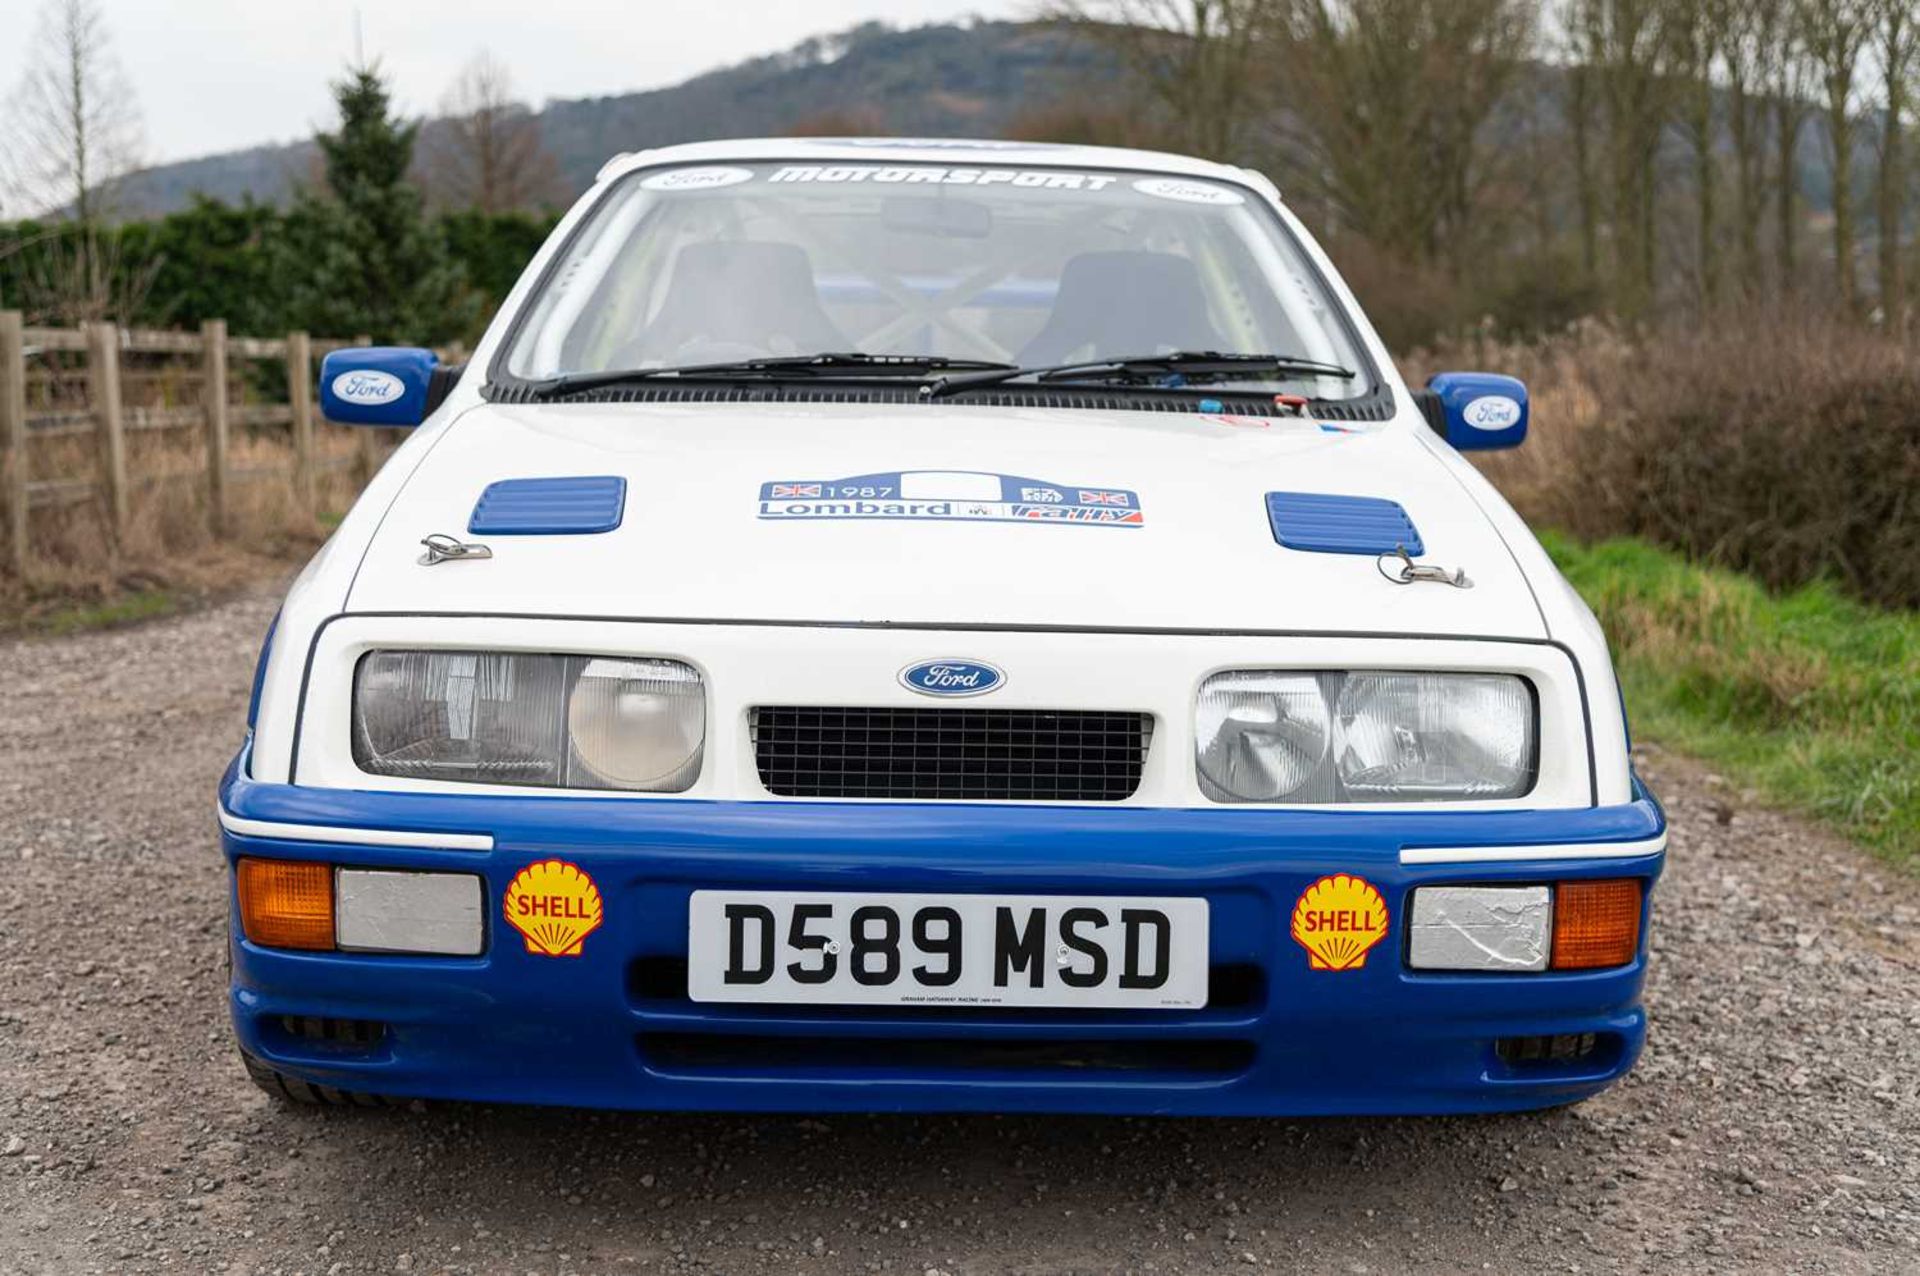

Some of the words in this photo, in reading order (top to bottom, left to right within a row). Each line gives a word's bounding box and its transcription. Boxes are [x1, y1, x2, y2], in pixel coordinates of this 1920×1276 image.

[768, 166, 1116, 190] MOTORSPORT
[345, 374, 392, 397] Ford
[1476, 401, 1513, 423] Ford
[827, 486, 893, 498] 1987
[760, 502, 952, 516] Lombard
[923, 664, 981, 687] Ford
[517, 894, 592, 919] SHELL
[1304, 910, 1378, 932] SHELL
[724, 903, 963, 987] D589
[993, 906, 1172, 990] MSD
